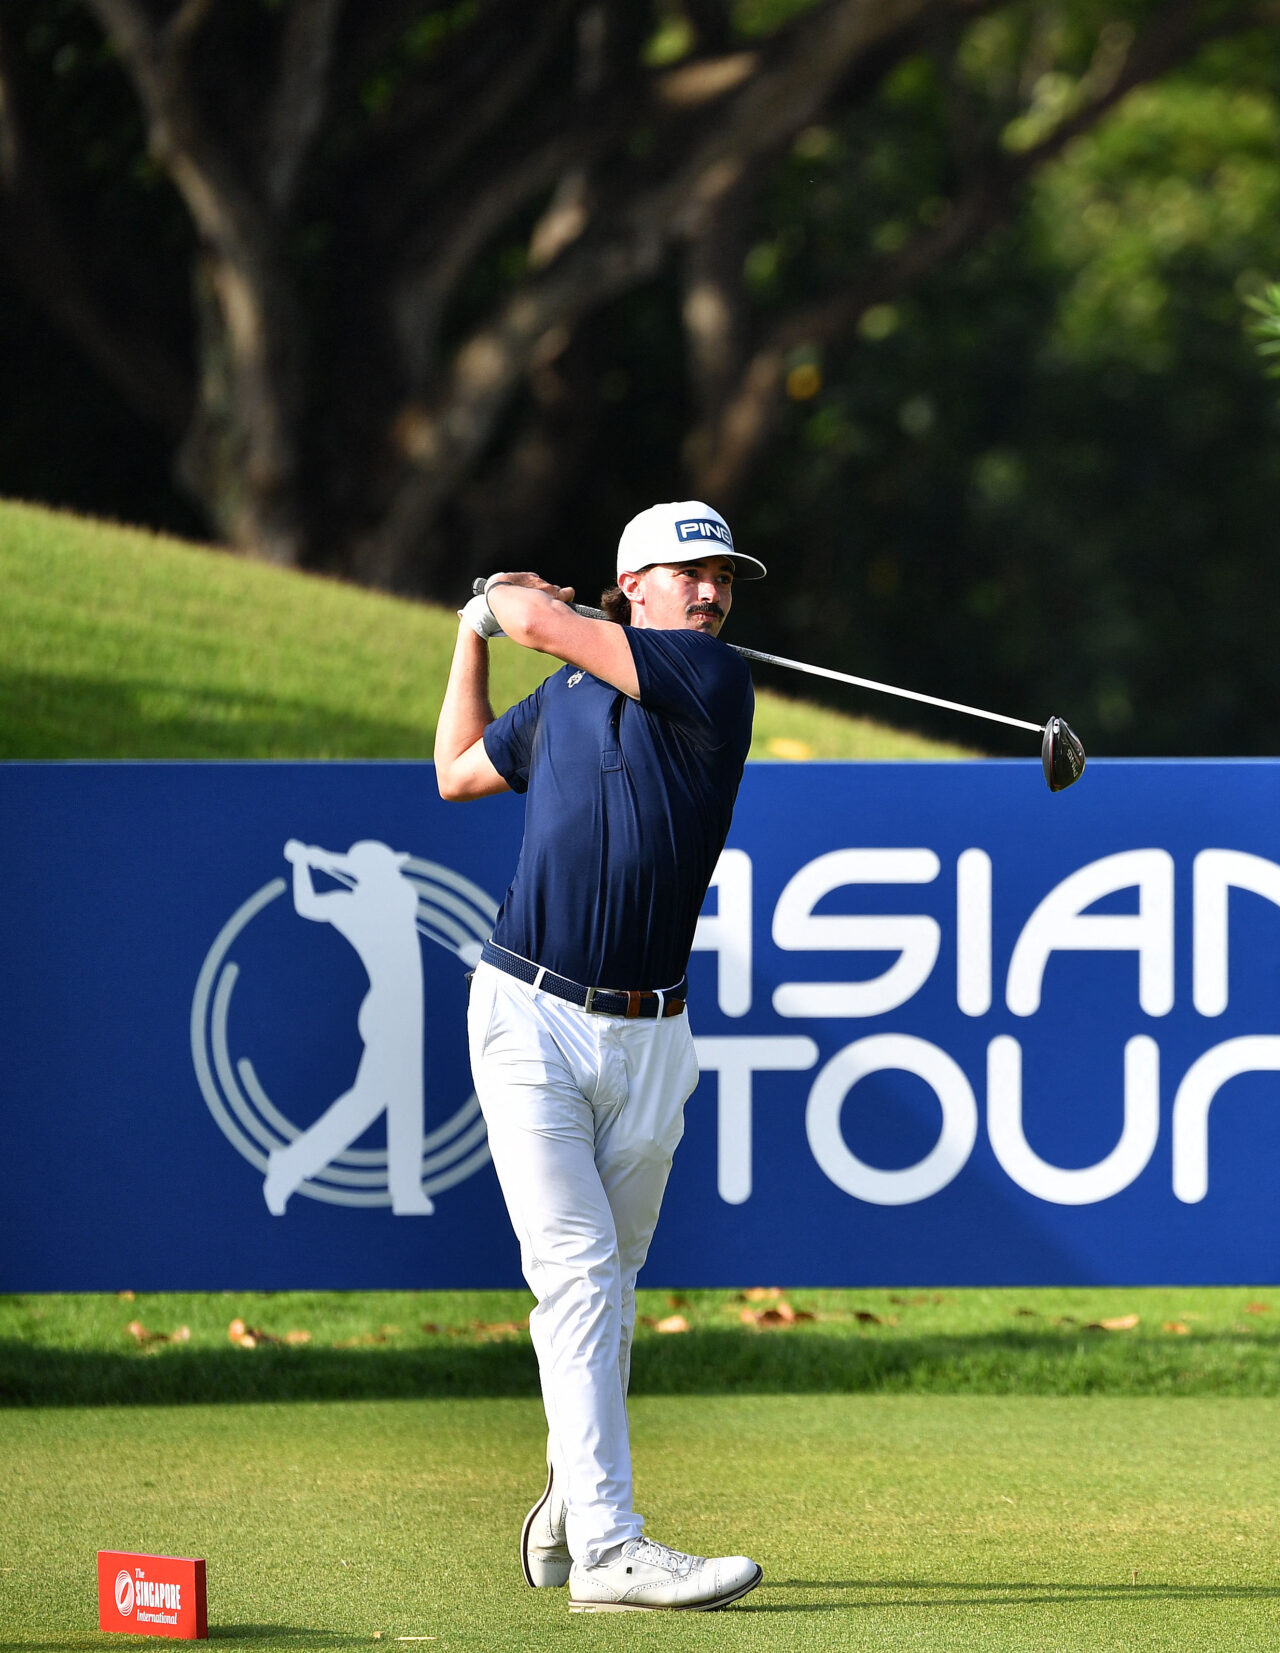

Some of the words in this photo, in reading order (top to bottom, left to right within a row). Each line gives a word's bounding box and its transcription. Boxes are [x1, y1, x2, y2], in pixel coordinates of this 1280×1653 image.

[680, 522, 731, 545] PING
[135, 1568, 145, 1579] The
[135, 1580, 182, 1610] SINGAPORE
[136, 1609, 178, 1625] International
